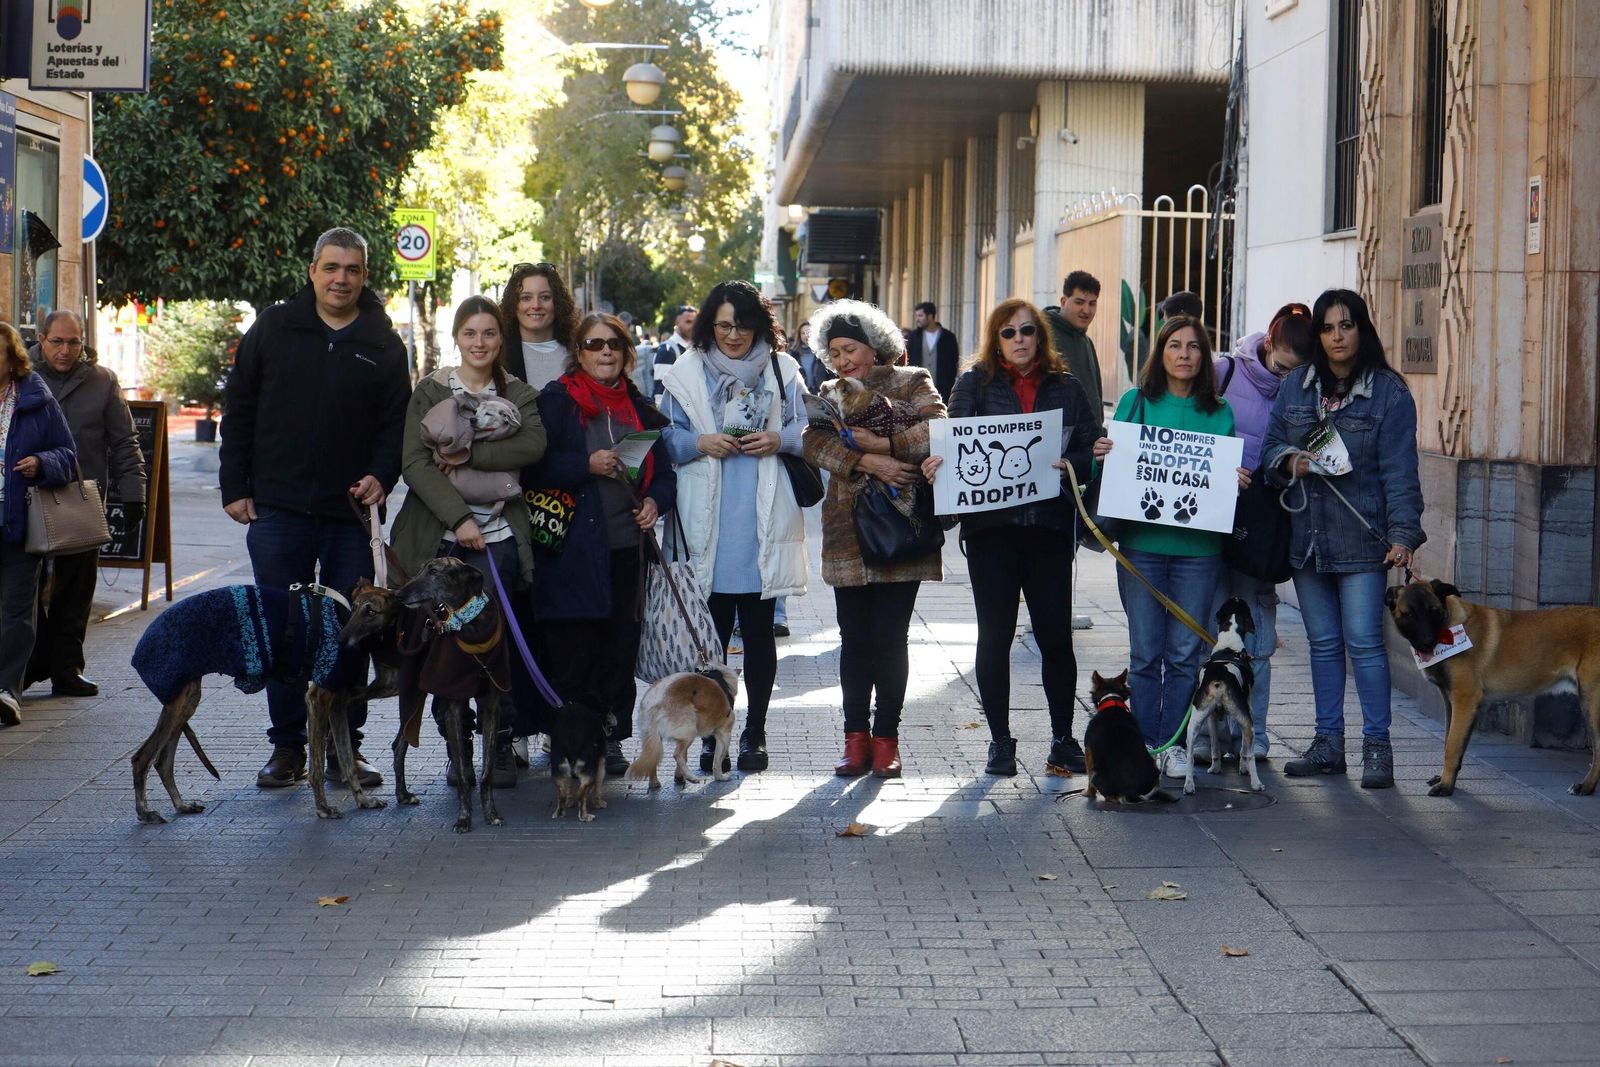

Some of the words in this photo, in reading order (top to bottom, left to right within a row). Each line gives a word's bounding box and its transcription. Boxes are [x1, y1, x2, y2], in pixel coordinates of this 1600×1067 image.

[47, 42, 93, 53] Loterías
[95, 45, 103, 56] y
[47, 55, 99, 67] Apuestas
[102, 56, 119, 67] del
[46, 68, 85, 79] Estado
[401, 235, 425, 250] 20
[952, 426, 973, 437] NO
[977, 420, 1043, 435] COMPRES
[1140, 425, 1174, 444] NO
[1174, 432, 1216, 446] COMPRES
[1139, 442, 1158, 450] UNO
[1173, 443, 1214, 458] RAZA
[1137, 451, 1212, 473] ADOPTA
[1136, 464, 1144, 480] UNO
[1143, 466, 1168, 483] SIN
[1172, 470, 1210, 489] CASA
[957, 481, 1038, 506] ADOPTA
